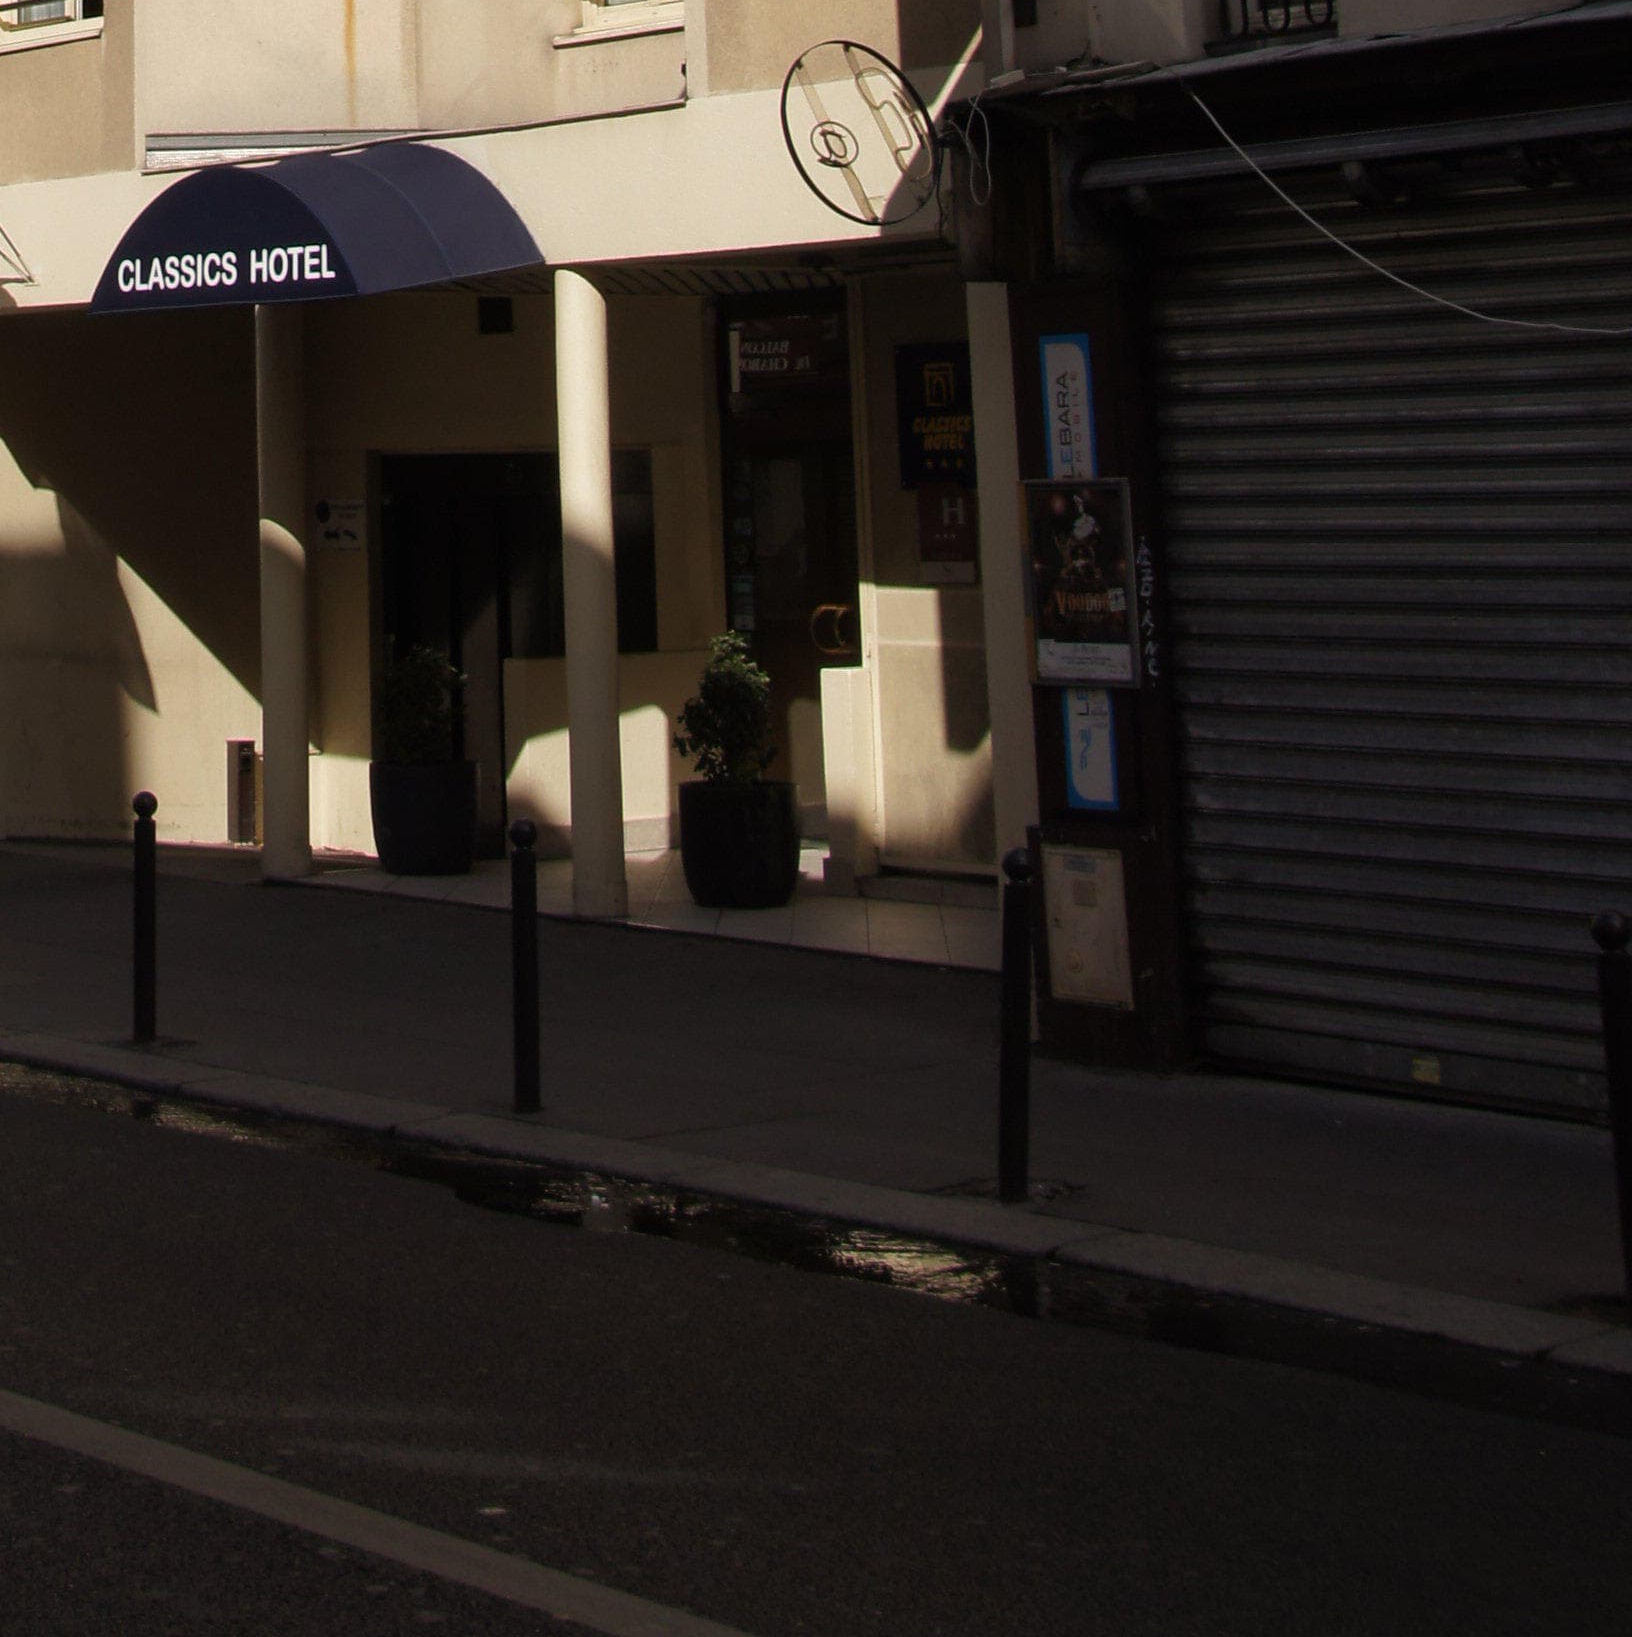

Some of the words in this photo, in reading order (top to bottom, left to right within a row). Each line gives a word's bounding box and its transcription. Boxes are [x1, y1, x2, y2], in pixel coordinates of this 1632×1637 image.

[118, 251, 237, 293] CLASSICS
[249, 243, 336, 284] HOTEL
[1055, 371, 1074, 479] LEBARA
